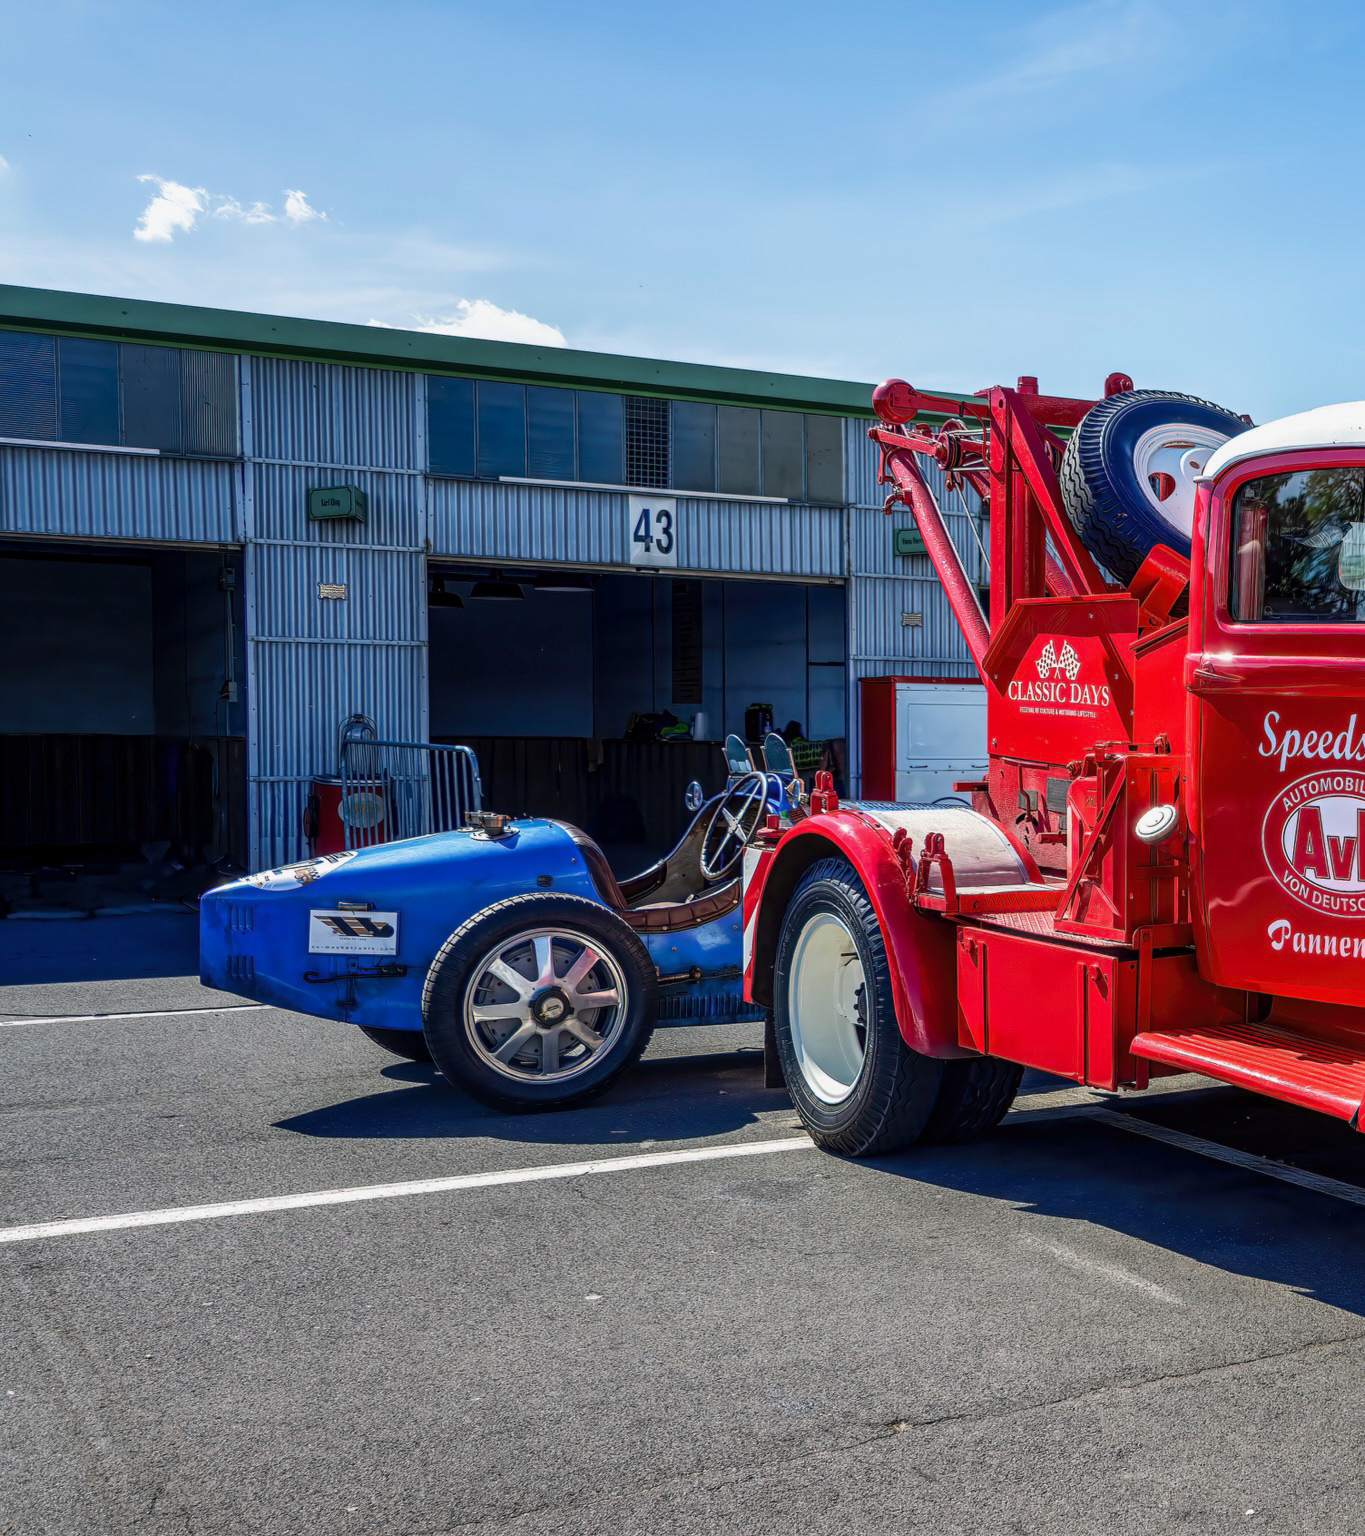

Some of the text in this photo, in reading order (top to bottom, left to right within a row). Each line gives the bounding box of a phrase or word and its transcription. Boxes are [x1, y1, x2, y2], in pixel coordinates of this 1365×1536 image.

[633, 508, 675, 555] 43
[1008, 680, 1111, 707] CLASSIC DAYS
[1281, 869, 1310, 900] VON
